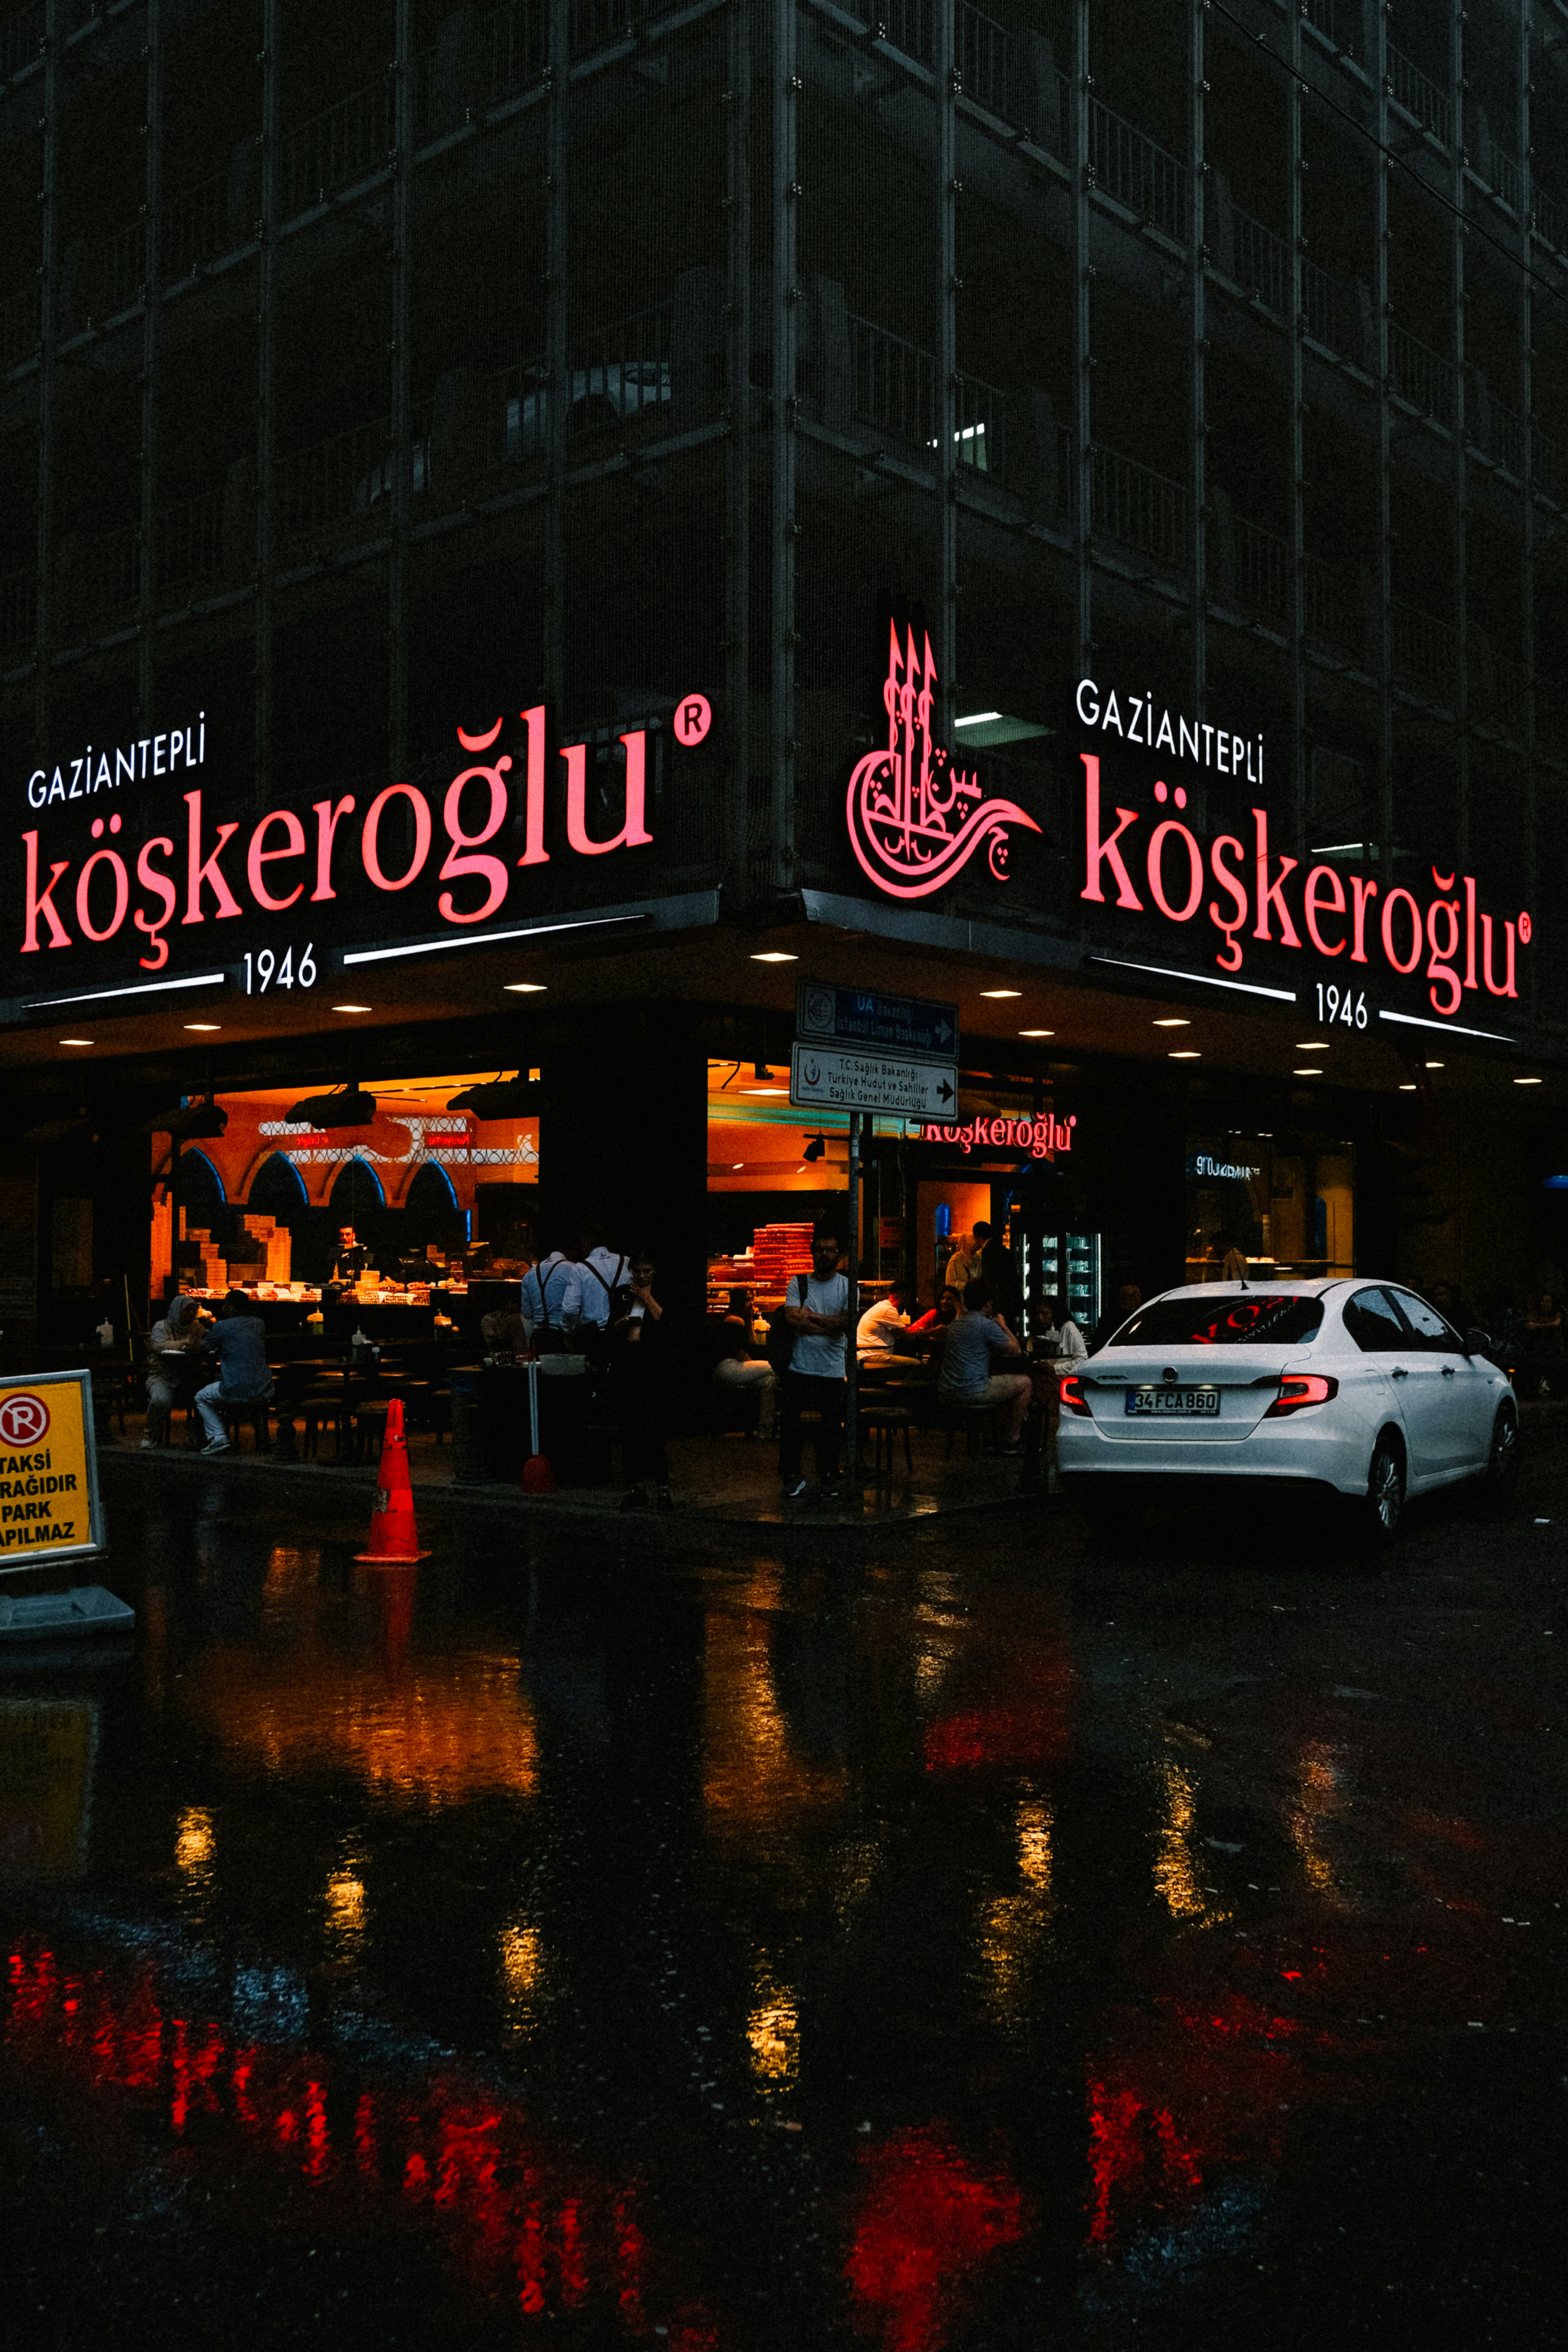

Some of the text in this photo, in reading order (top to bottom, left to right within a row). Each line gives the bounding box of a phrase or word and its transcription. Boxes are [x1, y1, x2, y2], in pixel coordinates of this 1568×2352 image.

[1077, 679, 1262, 784] GAZİANTEPLİ
[28, 711, 205, 808] GAZİANTEPLİ
[21, 705, 653, 969] köşkeroğlu
[1080, 753, 1518, 1015] köşkeroğlu
[244, 942, 316, 995] 1946
[1316, 983, 1367, 1029] 1946
[871, 1020, 893, 1038] Liman
[827, 1072, 929, 1095] Türkiye Hudut ve Sahiller
[839, 1059, 918, 1081] T.C. Sağlık Bakanlığı
[829, 1087, 855, 1101] Sağlık
[858, 1090, 880, 1103] Genel
[883, 1093, 926, 1110] Müdürlüğü
[1135, 1393, 1216, 1408] 34 FCA 860
[0, 1448, 51, 1475] TAKSİ
[2, 1500, 52, 1523] PARK
